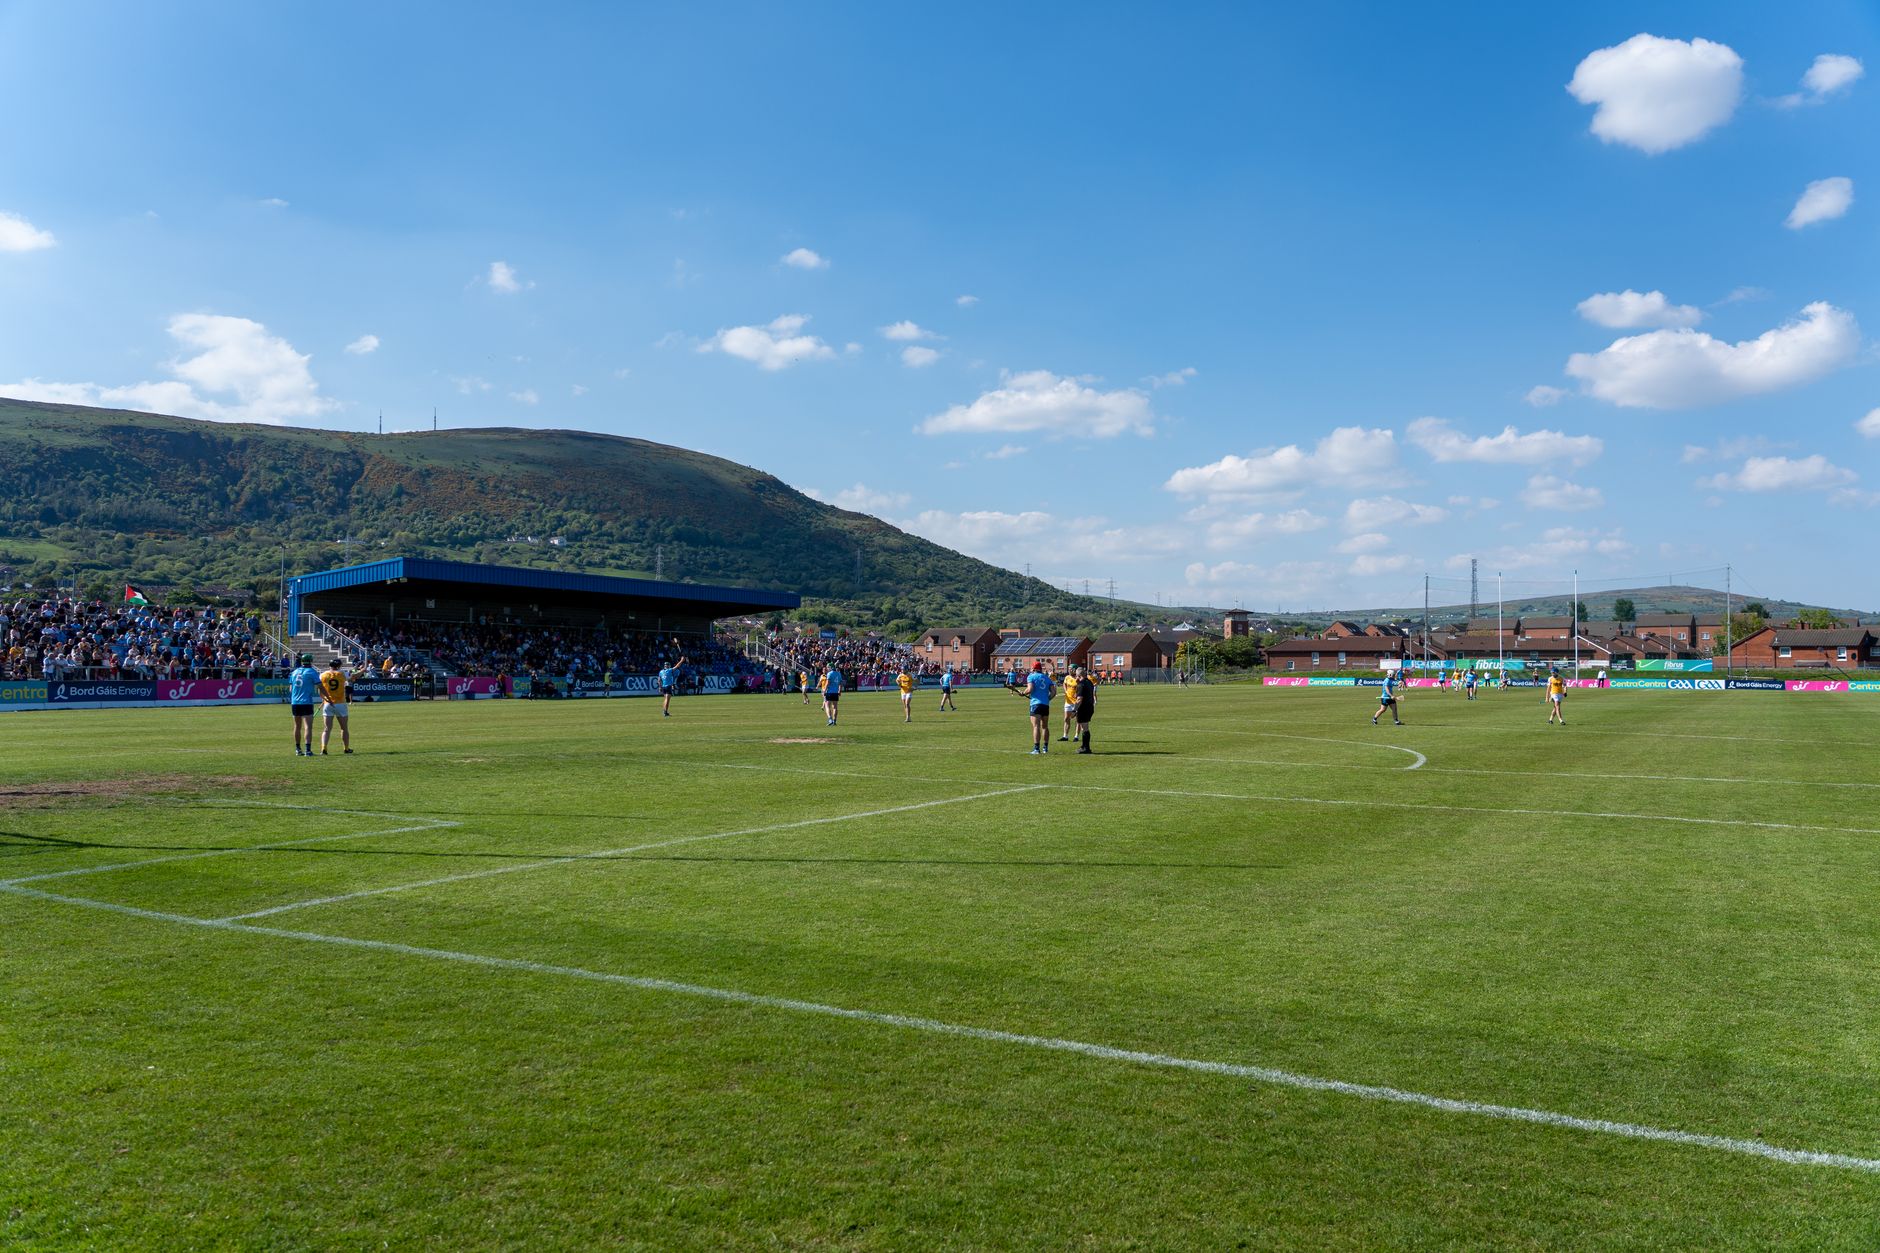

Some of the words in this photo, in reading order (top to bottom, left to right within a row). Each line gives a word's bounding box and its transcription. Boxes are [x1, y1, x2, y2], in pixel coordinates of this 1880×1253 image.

[1476, 660, 1504, 669] fibrus
[1664, 661, 1684, 669] fibrus
[294, 674, 304, 687] 5
[328, 679, 339, 691] 9
[456, 679, 474, 694] eir
[626, 677, 650, 690] GAA
[1040, 678, 1046, 689] 3
[1668, 680, 1694, 689] GAA
[1792, 681, 1810, 690] eir
[1824, 681, 1842, 691] eir
[0, 686, 48, 700] entra
[70, 686, 95, 696] Bord
[96, 685, 118, 696] Gáis
[118, 686, 152, 697] Energy
[169, 681, 196, 699] eir
[218, 680, 243, 698] eir
[353, 682, 372, 692] Bord
[372, 682, 388, 692] Gáis
[388, 682, 410, 692] Energy
